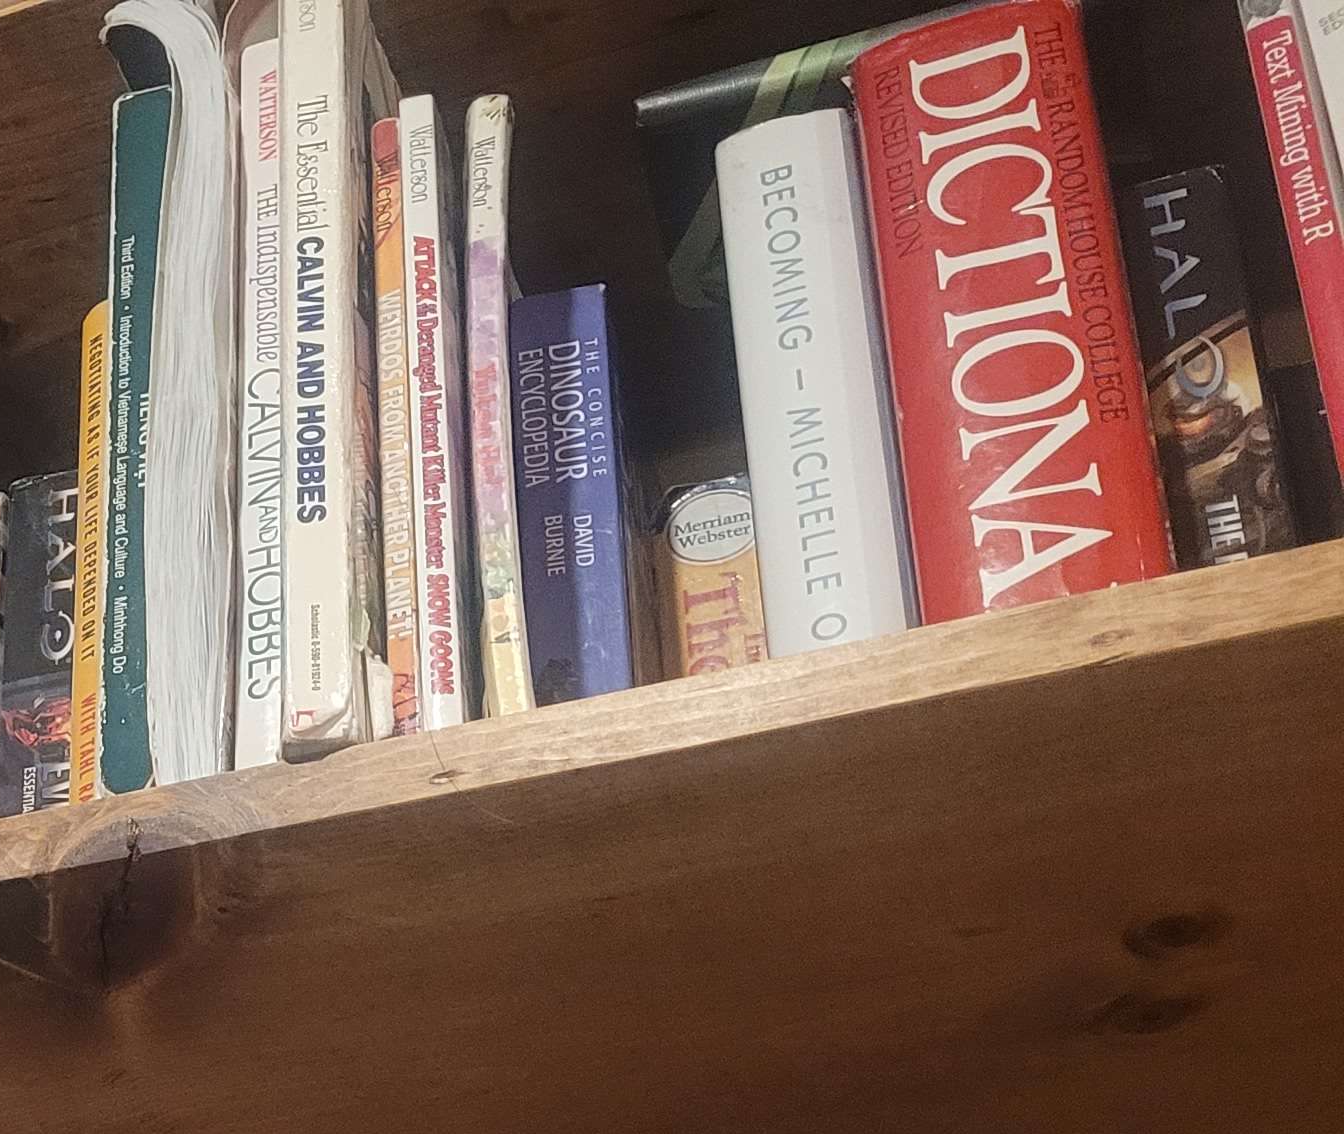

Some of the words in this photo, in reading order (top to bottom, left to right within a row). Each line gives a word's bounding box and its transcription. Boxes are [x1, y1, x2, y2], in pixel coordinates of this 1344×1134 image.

[1263, 30, 1296, 84] Text
[259, 69, 278, 162] WATTERSON
[296, 94, 330, 137] The
[875, 65, 904, 158] REVISED
[1273, 81, 1312, 166] Mining
[296, 139, 330, 233] Essential
[407, 124, 429, 204] Watterson
[472, 135, 496, 209] Watterson
[1291, 165, 1329, 222] with
[256, 183, 278, 221] THE
[887, 160, 923, 260] EDITION
[1302, 220, 1334, 245] R
[120, 235, 134, 264] Third
[413, 236, 438, 302] ATTACK
[760, 163, 814, 353] BECOMING
[119, 264, 134, 300] Edition
[249, 224, 280, 363] Indispensable
[296, 235, 325, 333] CALVIN
[118, 314, 133, 374] Introduction
[377, 288, 403, 382] WEIRDOS
[413, 317, 442, 393] Deranged
[584, 337, 600, 376] THE
[1081, 306, 1129, 425] COLLEGE
[87, 333, 103, 422] NEGOTIATING
[296, 340, 326, 399] AND
[86, 424, 100, 446] AS
[116, 390, 131, 454] Vietnamese
[247, 367, 281, 507] CALVIN
[382, 383, 406, 450] FROM
[420, 393, 443, 454] Mutant
[518, 350, 551, 489] ENCYCLOPEDIA
[547, 340, 588, 484] DINOSAUR
[588, 387, 607, 478] CONCISE
[85, 464, 99, 503] YOUR
[112, 455, 130, 511] Language
[296, 403, 327, 524] HOBBES
[422, 454, 446, 501] Killer
[84, 504, 98, 539] LIFE
[114, 512, 128, 535] and
[674, 511, 750, 537] Merriam
[786, 407, 846, 596] MICHELLE
[114, 536, 129, 578] Culture
[423, 502, 446, 569] Monster
[544, 515, 566, 577] BURNIE
[573, 514, 596, 568] DAVID
[678, 525, 751, 549] Webster
[82, 540, 98, 617] DEPENDED
[427, 574, 451, 628] SNOW
[81, 618, 96, 641] ON
[111, 596, 128, 655] Minhhong
[247, 544, 281, 700] HOBBES
[112, 655, 127, 674] Do
